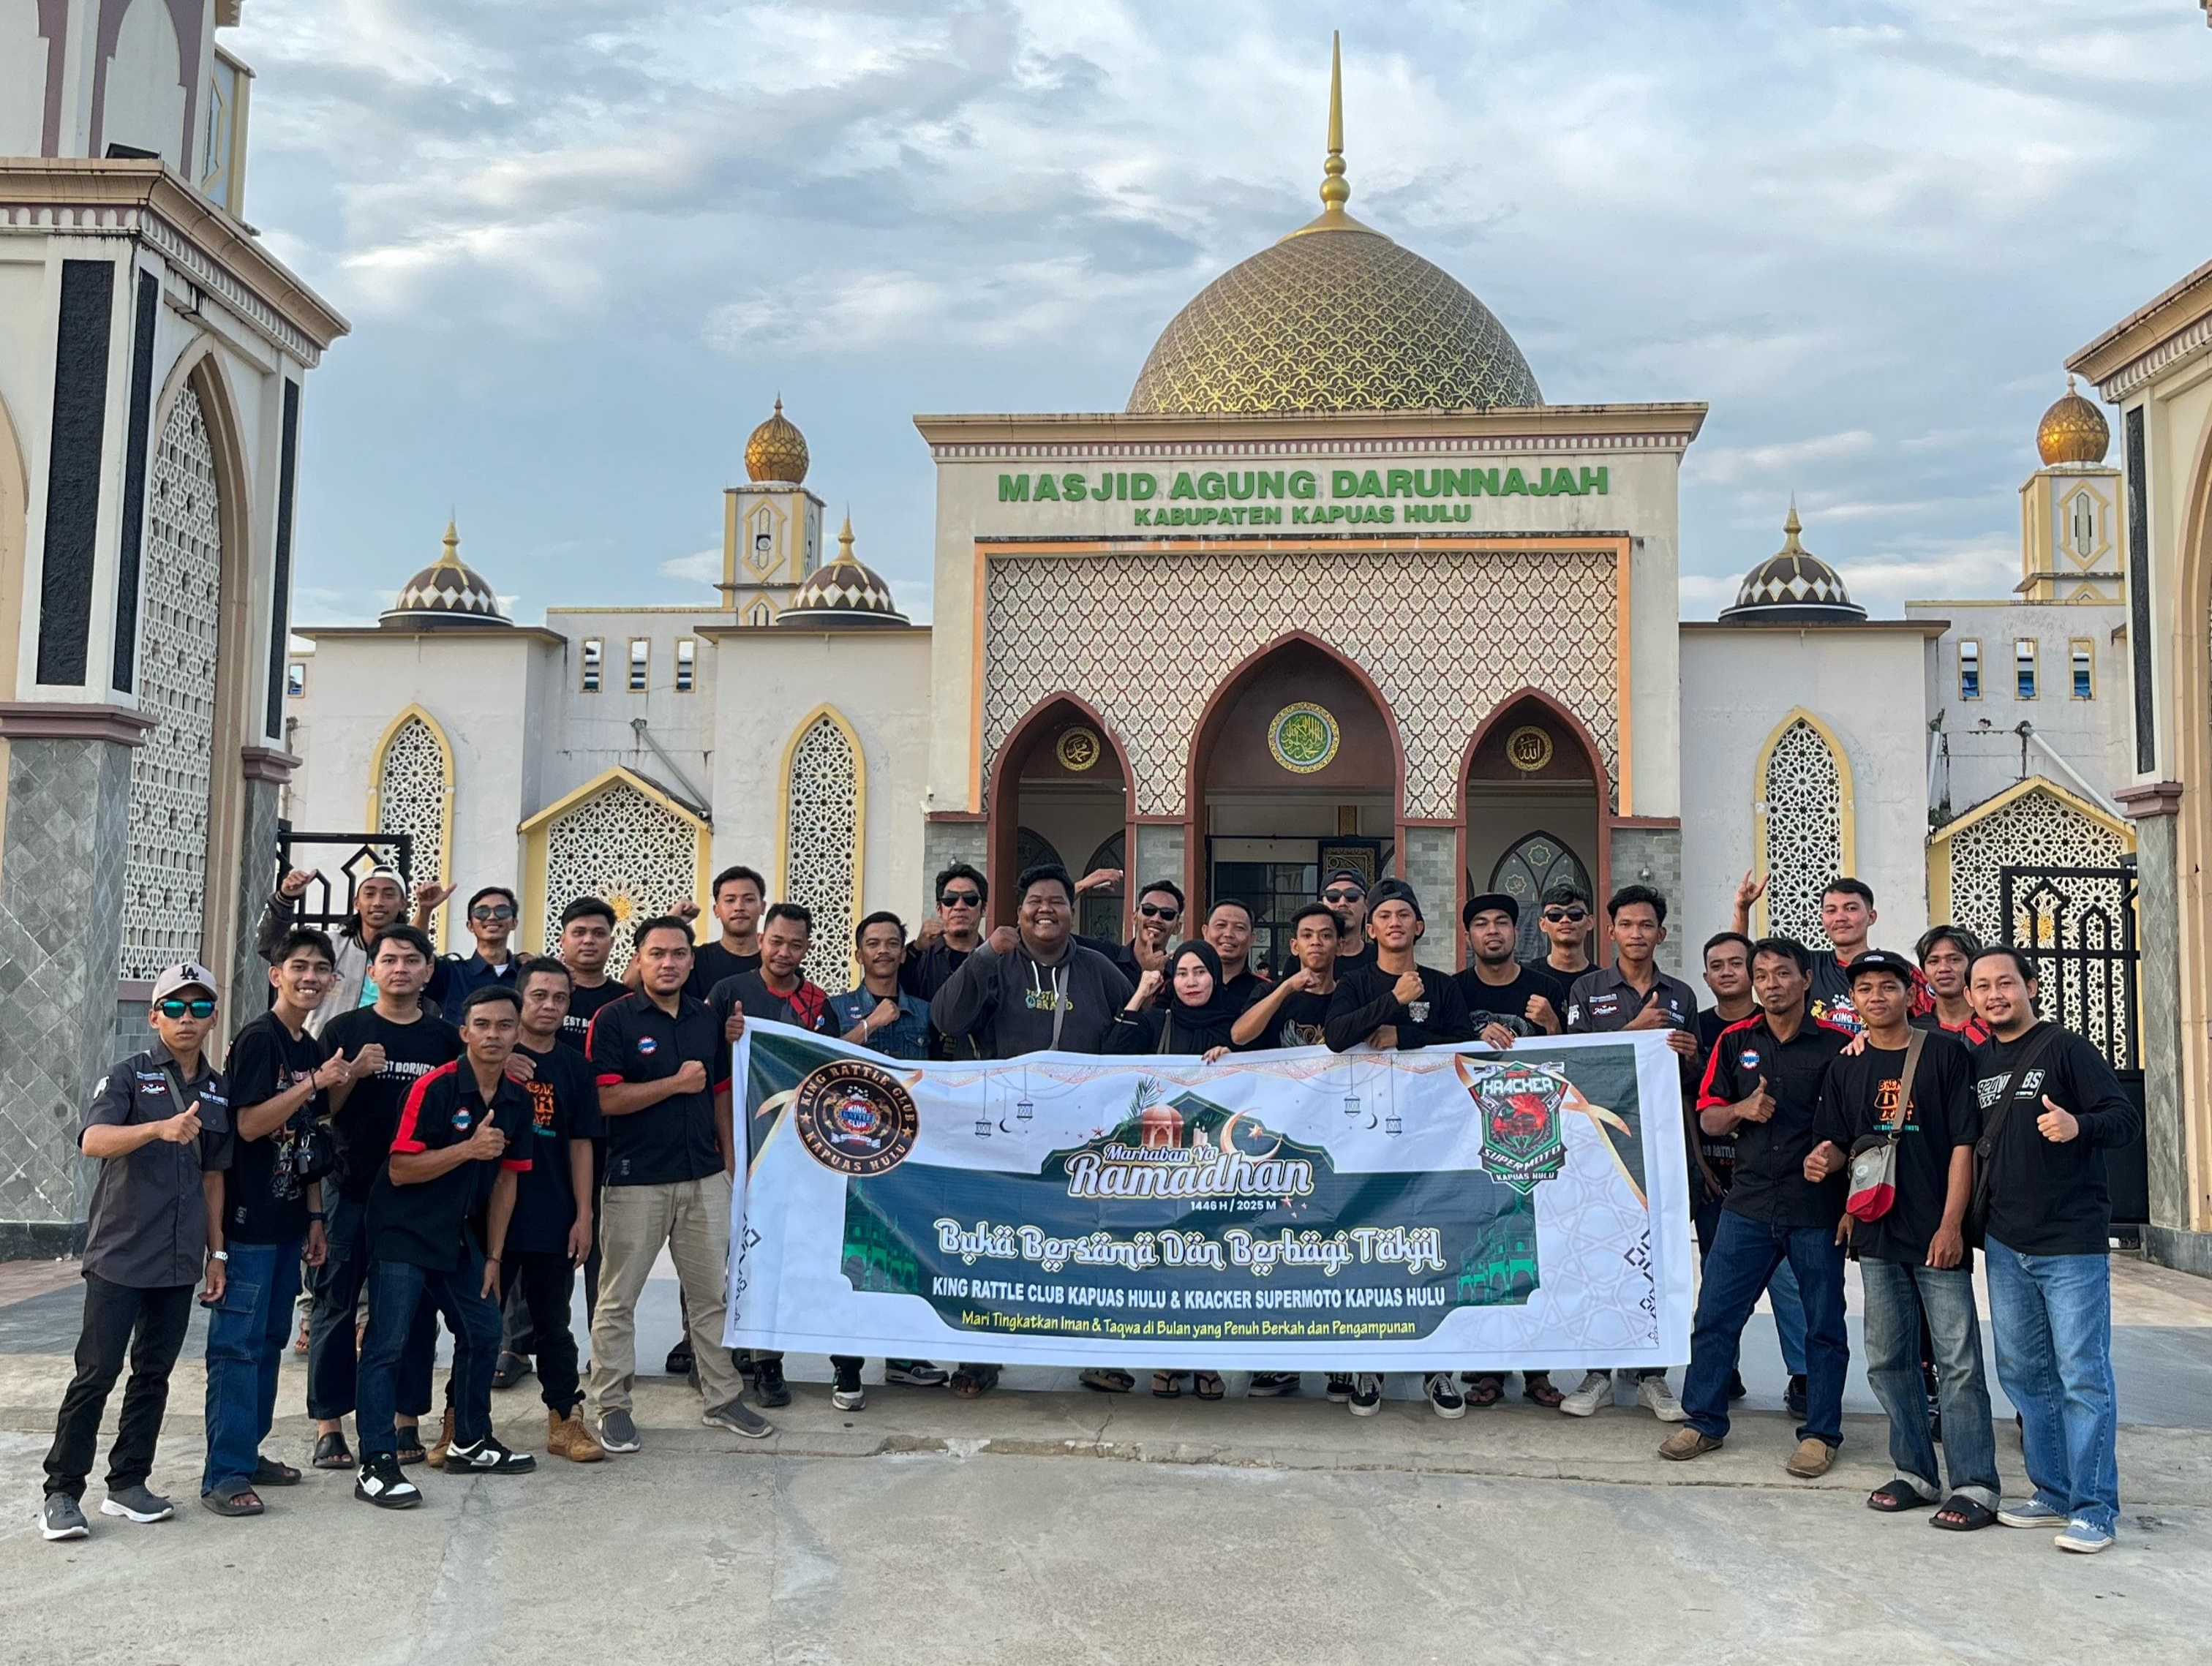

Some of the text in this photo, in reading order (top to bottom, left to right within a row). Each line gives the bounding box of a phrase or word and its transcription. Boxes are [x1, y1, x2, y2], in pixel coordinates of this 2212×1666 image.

[998, 466, 1609, 502] MASJID AGUNG DARUNNAJAH
[1134, 504, 1472, 527] KABUPATEN KAPUAS HULU
[180, 964, 199, 981] LA
[563, 1015, 582, 1027] EST
[1832, 1012, 1853, 1023] KING
[801, 1065, 916, 1122] KING RATTLE CLUB
[805, 1131, 907, 1172] KAPUAS HULU
[1103, 1144, 1219, 1164] Marhaban Ya
[1482, 1145, 1561, 1171] SUPERMOTO
[1066, 1150, 1314, 1199] Ramadhan
[1496, 1171, 1555, 1181] KAPUAS HULU
[1190, 1201, 1217, 1211] 1446
[1219, 1201, 1228, 1210] H
[1236, 1200, 1264, 1211] 2025
[1265, 1200, 1277, 1210] M
[932, 1277, 1445, 1309] KING RATTLE CLUB KAPUAS HULU & KRACKER SUPERMOTO KAPUAS HULU
[961, 1310, 1415, 1339] Mari Tingkatkan Iman & Taqwa di Bulan yang Penuh Berkah dan Pengampunan
